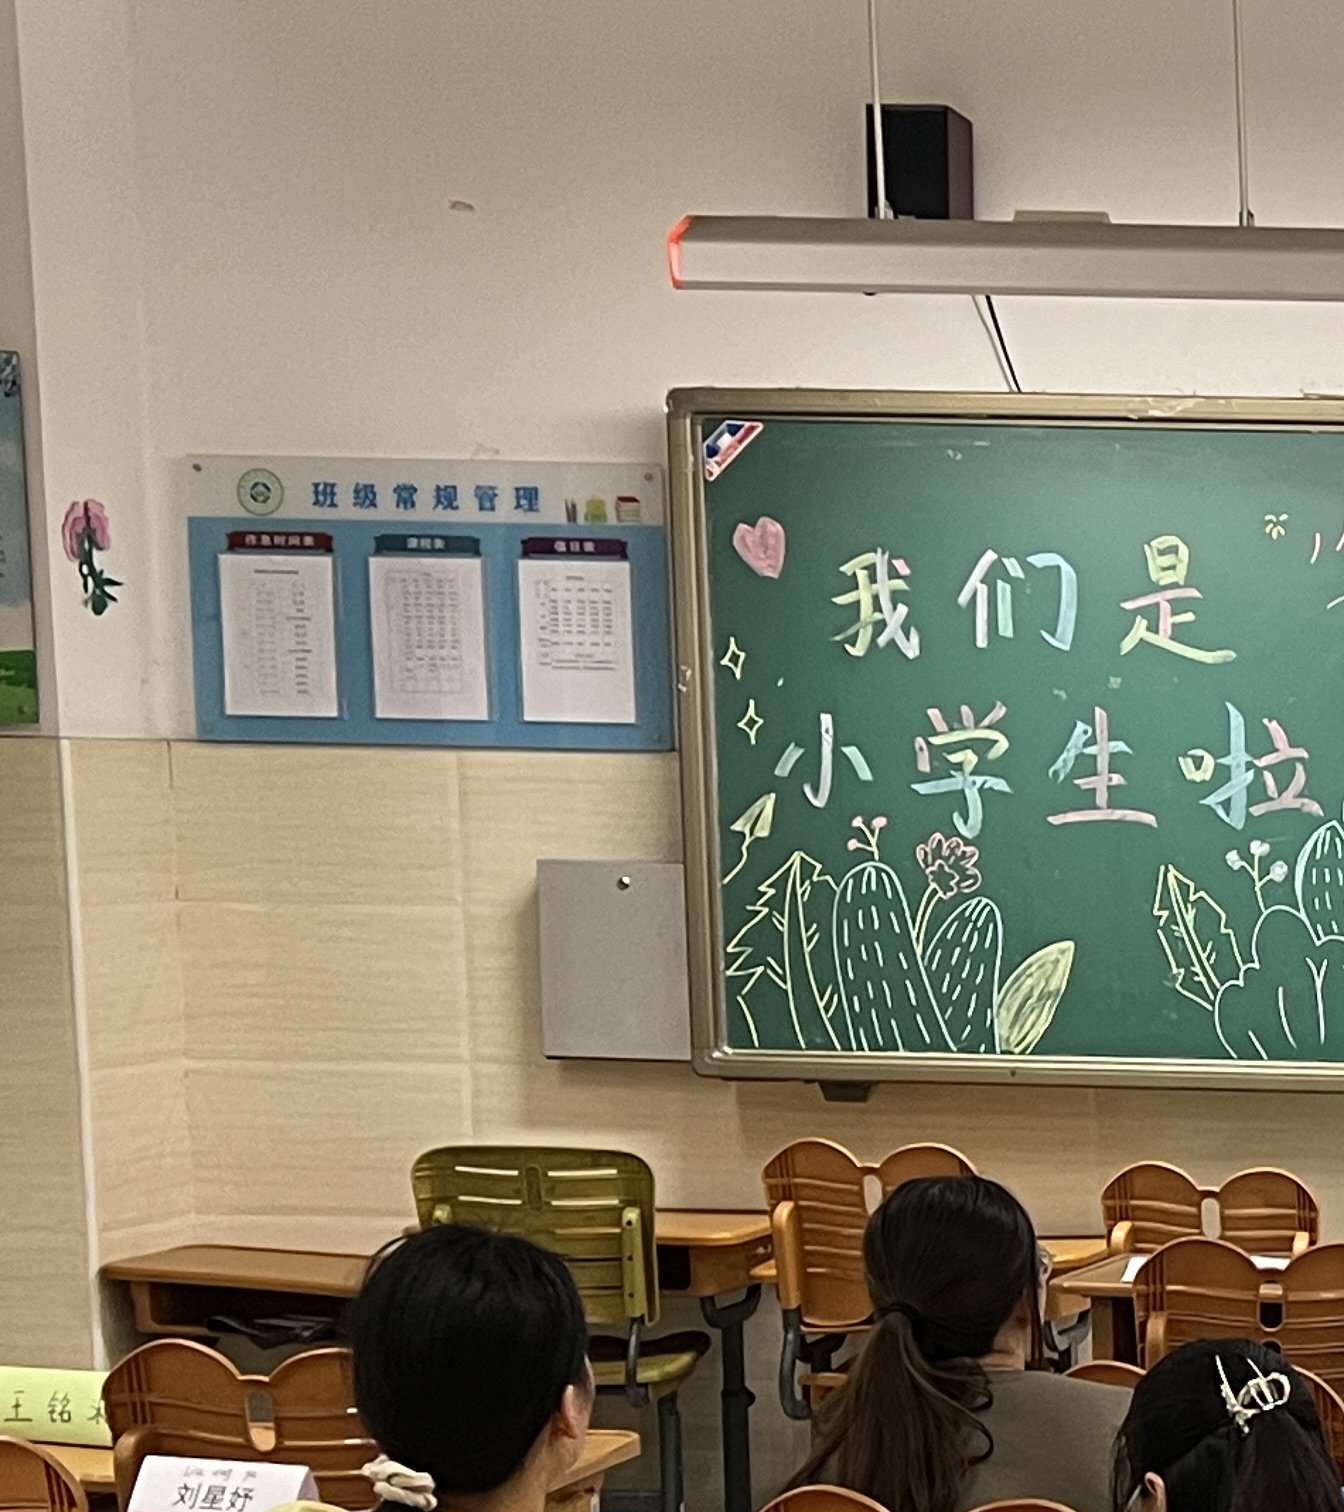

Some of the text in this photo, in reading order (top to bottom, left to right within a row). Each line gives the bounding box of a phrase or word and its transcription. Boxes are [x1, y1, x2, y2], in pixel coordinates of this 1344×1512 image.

[311, 481, 541, 513] 班级常规管理
[831, 535, 1238, 664] 我们是
